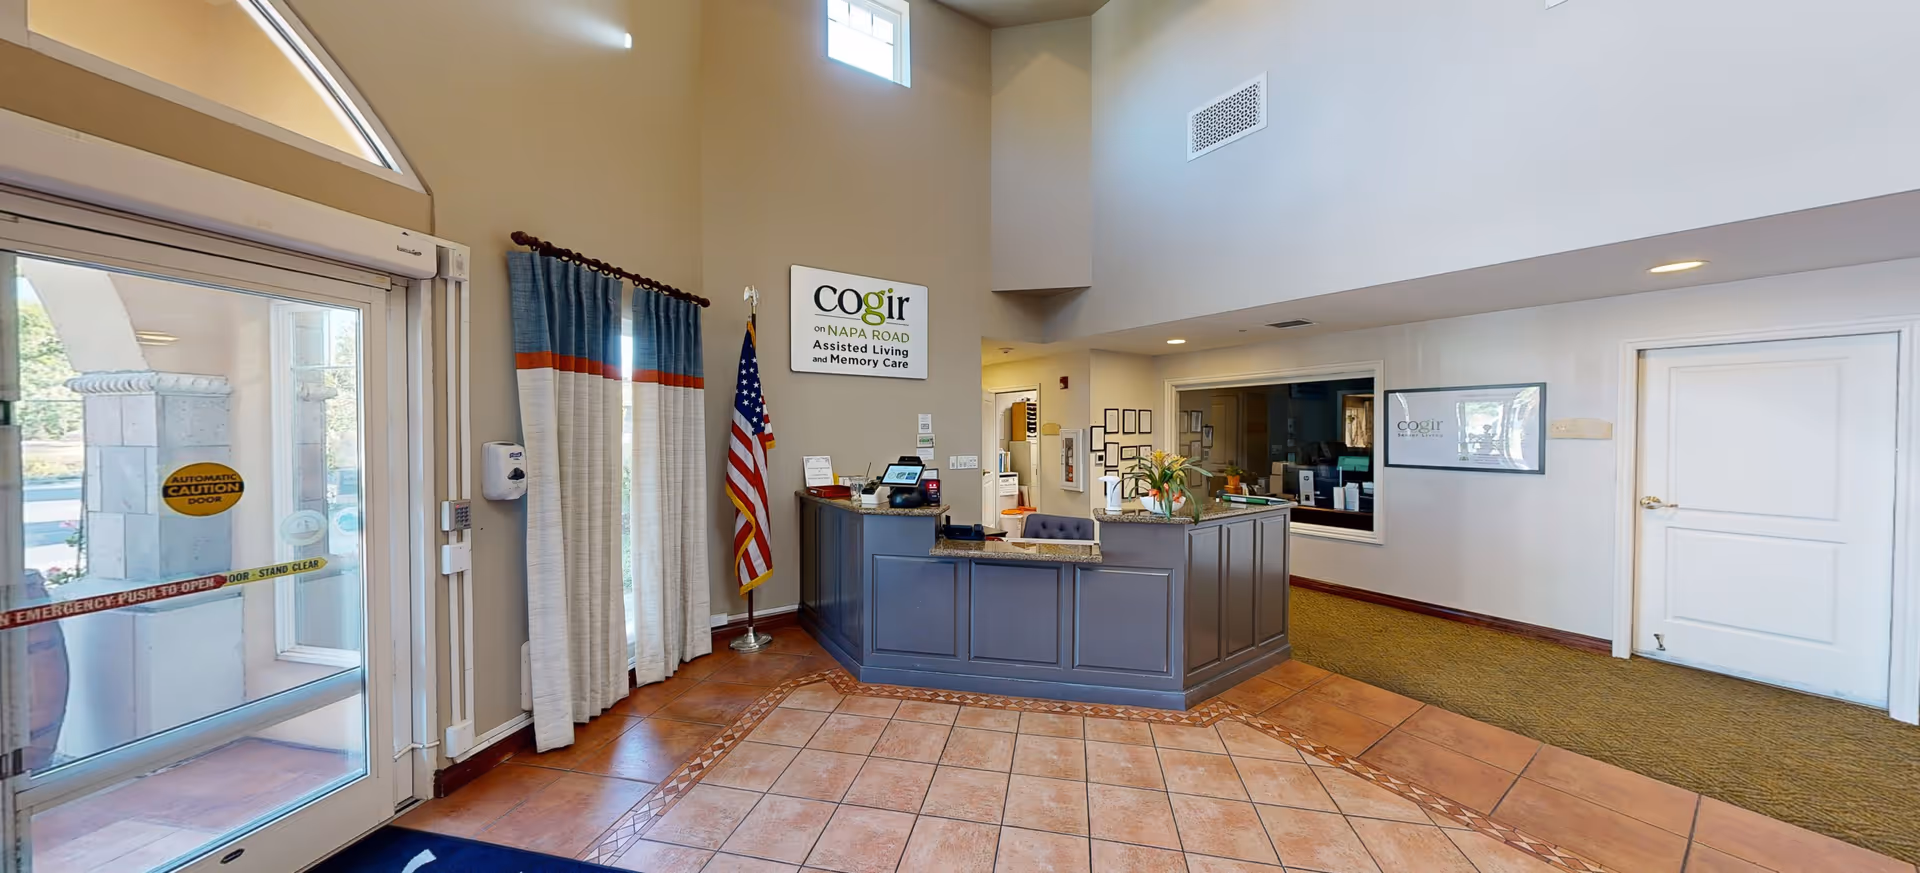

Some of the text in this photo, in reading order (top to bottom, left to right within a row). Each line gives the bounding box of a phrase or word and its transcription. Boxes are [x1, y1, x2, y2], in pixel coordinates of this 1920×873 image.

[814, 285, 910, 326] cogir
[828, 325, 867, 339] NAPA
[872, 329, 909, 343] ROAD
[813, 340, 909, 358] Assisted Living
[830, 354, 878, 368] Memory
[883, 358, 909, 368] Care
[1397, 418, 1444, 434] cogir
[171, 473, 237, 483] AUTOMATIC
[167, 483, 240, 496] CAUTION
[188, 496, 222, 505] DOOR
[225, 571, 249, 583] OOR
[258, 565, 288, 577] STAND
[292, 560, 319, 572] CLEAR
[17, 598, 114, 624] EMERGENCY
[118, 588, 156, 606] PUSH
[161, 583, 178, 597] TO
[183, 577, 215, 593] OPEN
